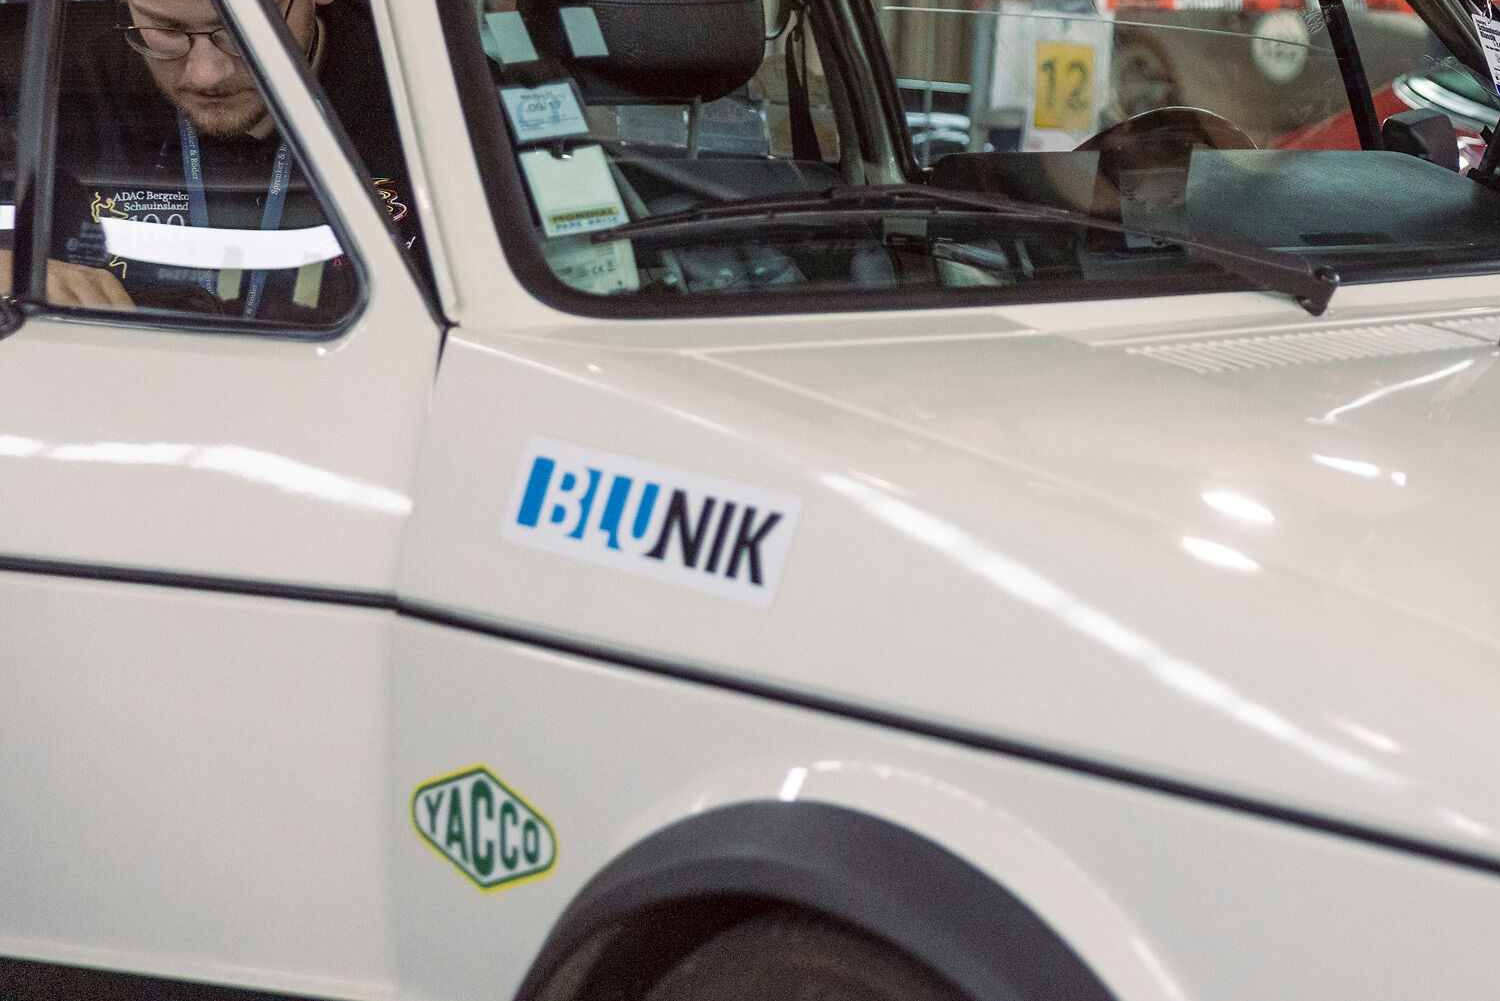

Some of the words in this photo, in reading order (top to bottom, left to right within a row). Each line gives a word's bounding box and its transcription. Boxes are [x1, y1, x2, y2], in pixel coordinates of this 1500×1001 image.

[1040, 59, 1089, 110] 12
[113, 191, 145, 201] ADAC
[146, 191, 189, 203] Bergreko
[123, 202, 189, 211] Schauinsland
[516, 455, 783, 587] BLUNIK
[425, 778, 541, 877] YACCO
